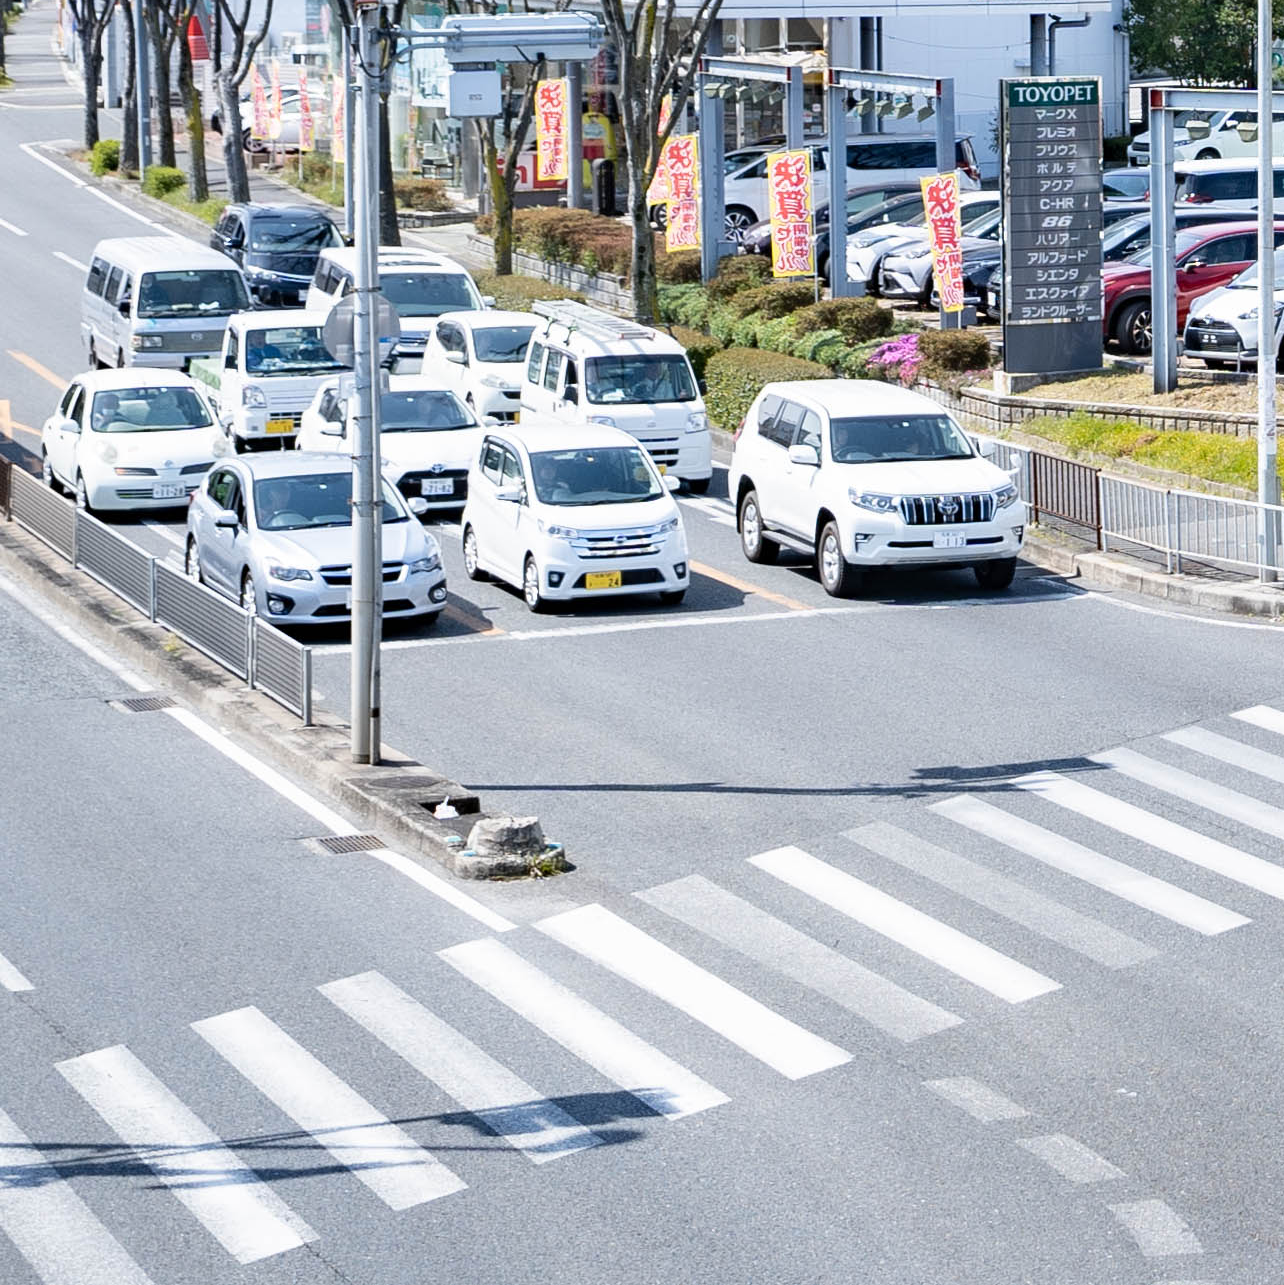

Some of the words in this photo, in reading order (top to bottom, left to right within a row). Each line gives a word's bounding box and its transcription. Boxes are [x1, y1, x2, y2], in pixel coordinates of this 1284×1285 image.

[1014, 85, 1094, 103] TOYOPET
[1034, 108, 1078, 120] マークX
[1040, 179, 1074, 192] アクア
[1040, 198, 1074, 210] C-HR
[1041, 216, 1073, 228] 86
[1035, 233, 1081, 245] ハリアー
[1027, 249, 1088, 265] アルファード
[1037, 268, 1079, 282] シエンタ
[1025, 285, 1089, 300] エスクァイア
[1021, 304, 1093, 318] ランドクルーザー
